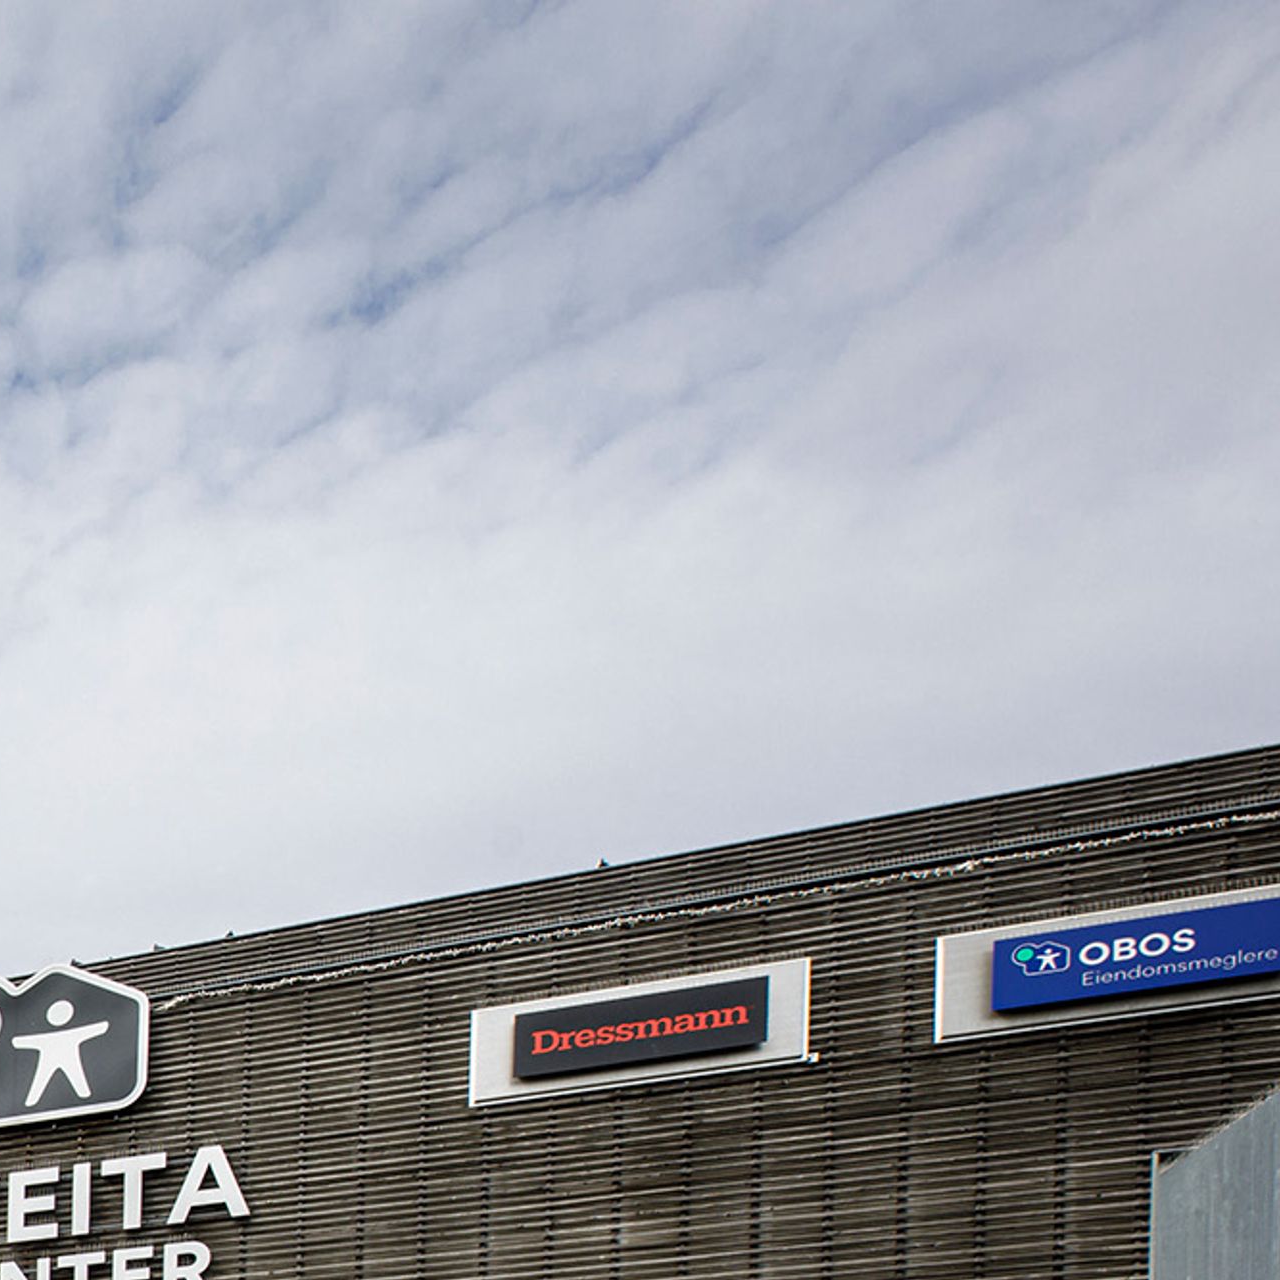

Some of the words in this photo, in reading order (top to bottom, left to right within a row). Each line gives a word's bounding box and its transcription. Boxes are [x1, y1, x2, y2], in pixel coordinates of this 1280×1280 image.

[1078, 928, 1196, 965] OBOS
[1081, 948, 1279, 986] Eiendomsmeglere
[530, 1004, 749, 1055] Dressmann
